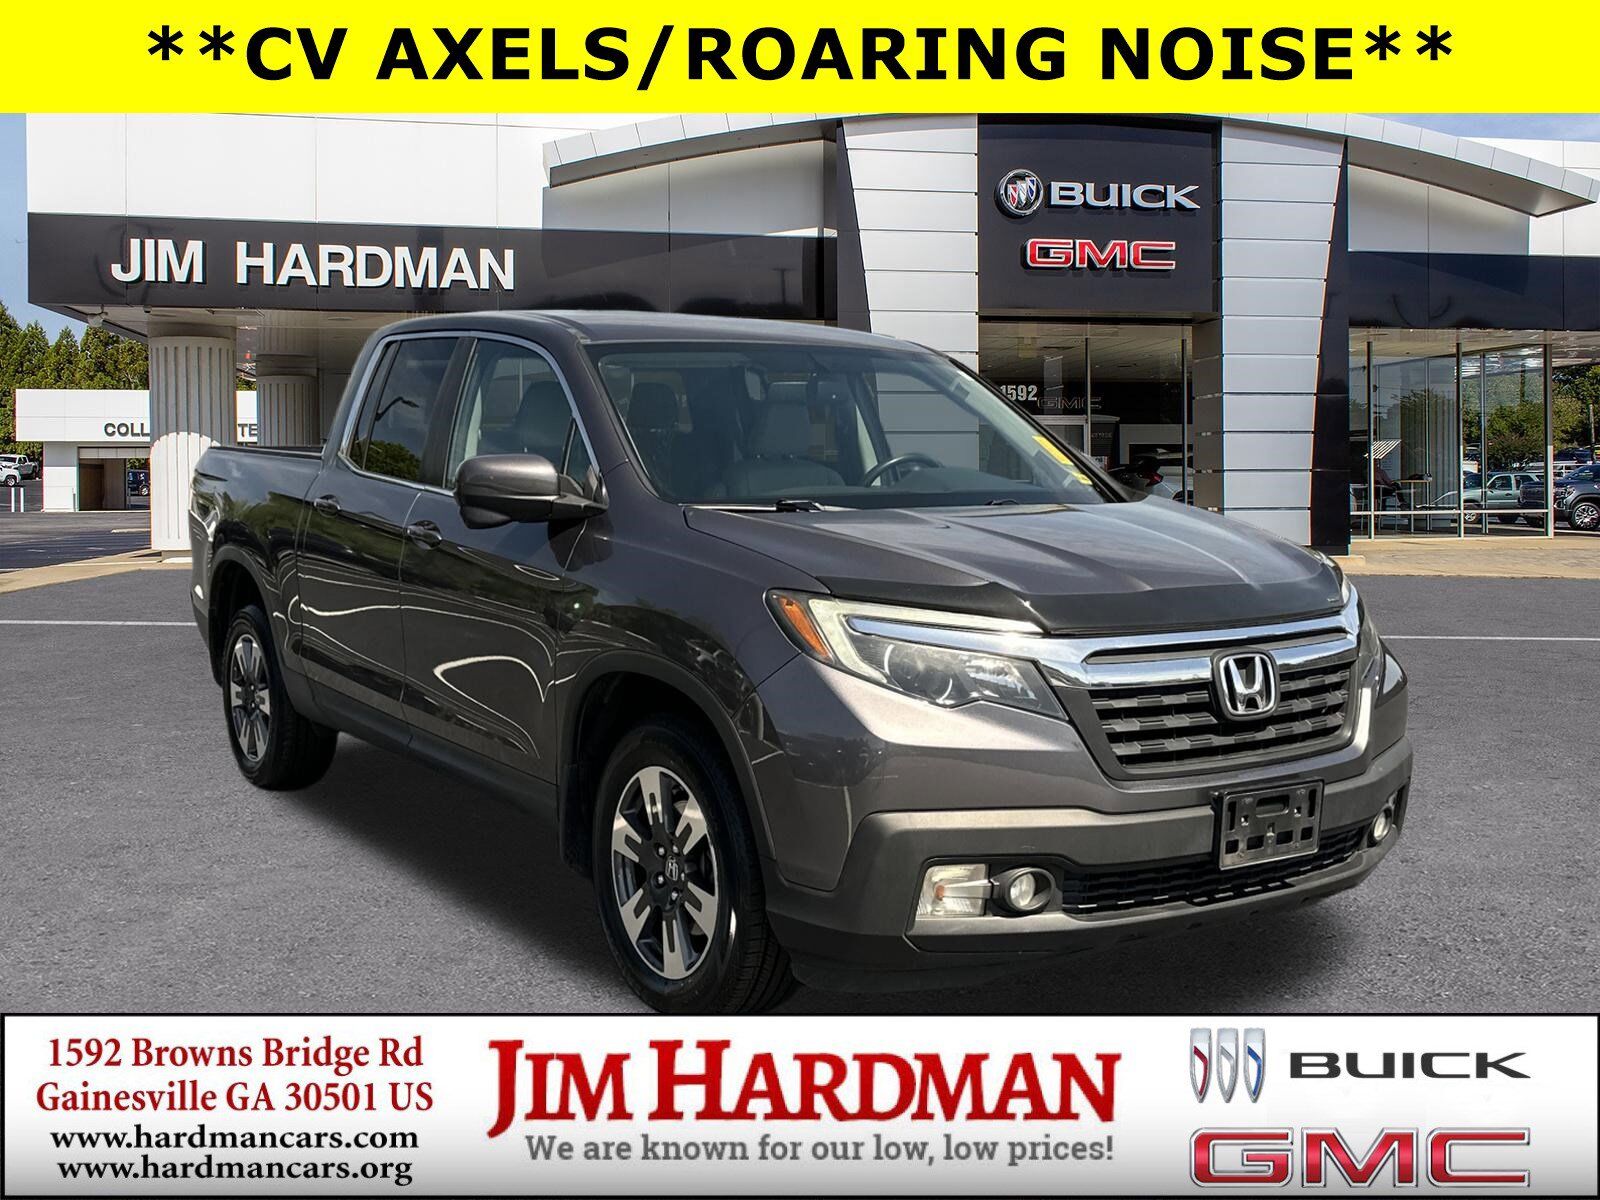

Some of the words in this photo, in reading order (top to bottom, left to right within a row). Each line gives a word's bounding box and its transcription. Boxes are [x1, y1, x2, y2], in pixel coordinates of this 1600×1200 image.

[1050, 181, 1200, 209] BUICK
[111, 238, 204, 284] JIM
[236, 240, 516, 291] HARDMAN
[1026, 238, 1176, 270] GMC
[1000, 385, 1037, 401] 1592
